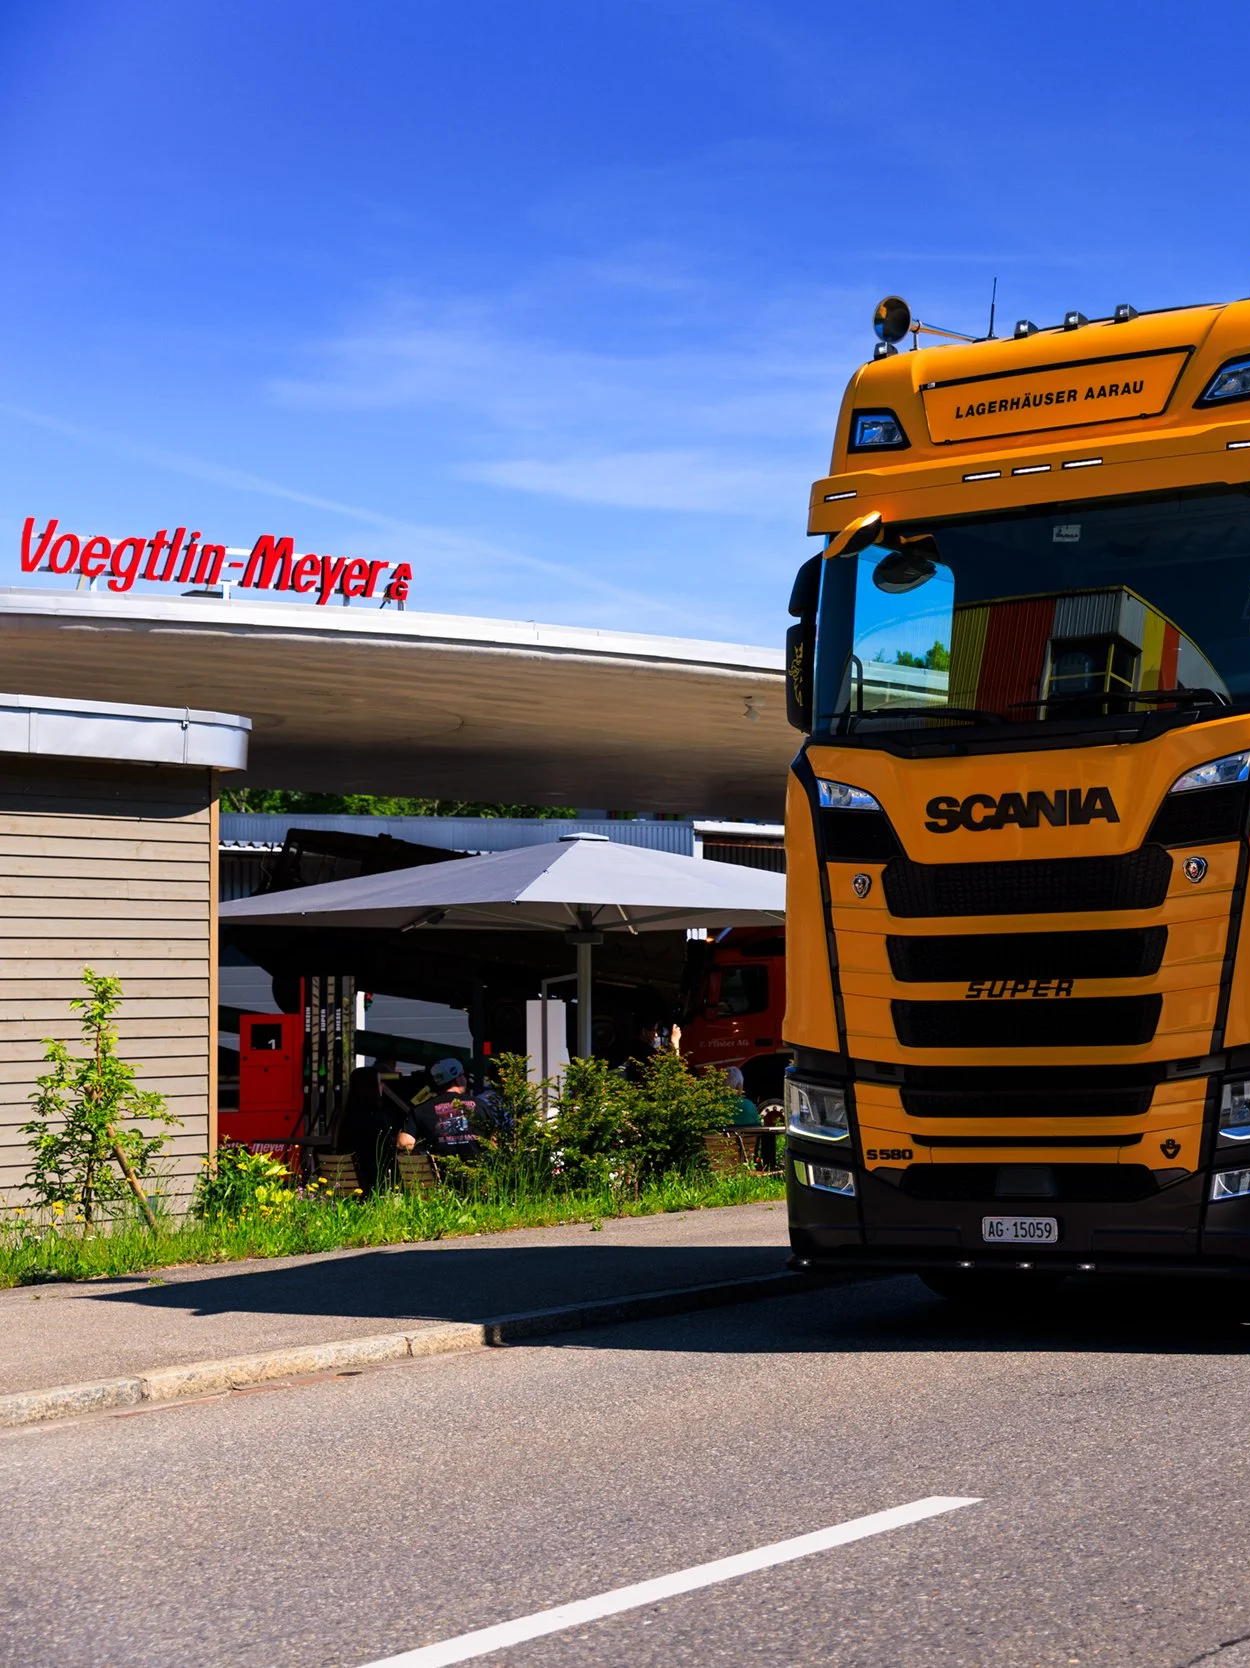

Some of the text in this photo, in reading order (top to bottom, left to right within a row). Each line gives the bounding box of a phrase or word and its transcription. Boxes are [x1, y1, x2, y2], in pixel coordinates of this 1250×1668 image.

[955, 380, 1144, 419] LAGERHÄUSER AARAU
[20, 516, 389, 605] Voegtlin-Meyer
[924, 787, 1120, 834] SCANIA
[965, 979, 1074, 999] SUPER
[268, 1039, 276, 1049] 1
